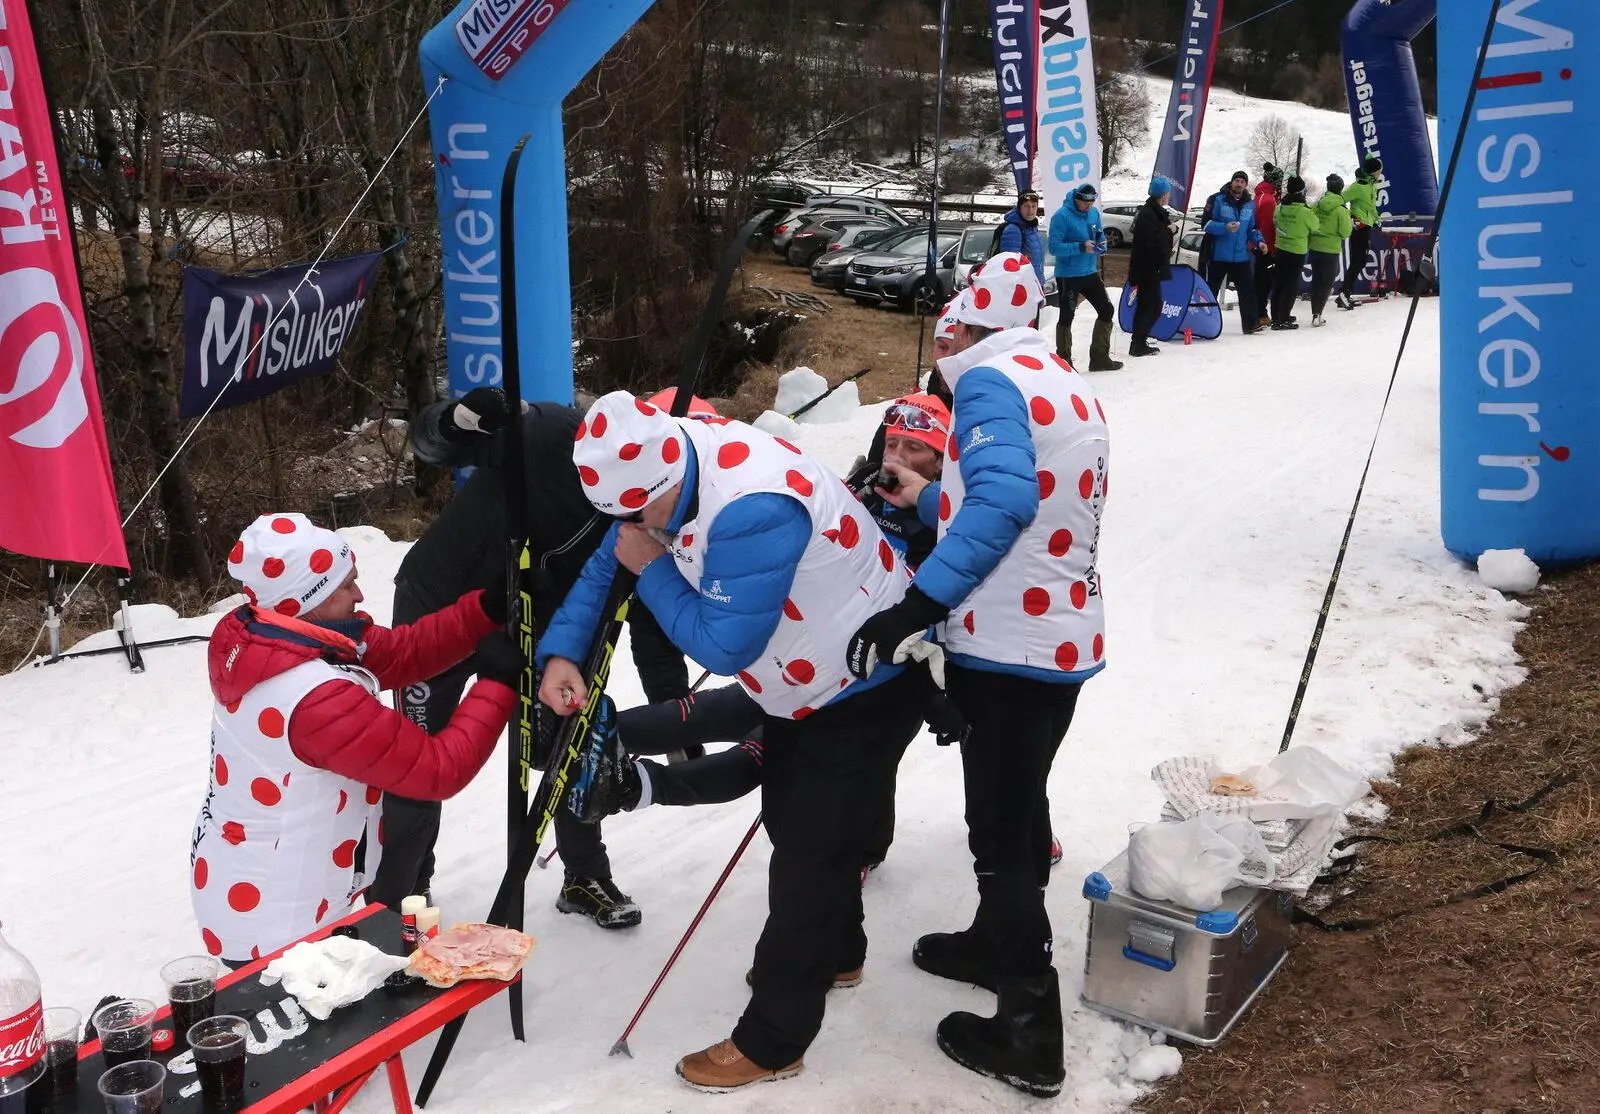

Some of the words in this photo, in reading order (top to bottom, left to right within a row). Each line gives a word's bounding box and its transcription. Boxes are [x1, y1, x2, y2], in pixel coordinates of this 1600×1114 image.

[461, 0, 518, 49] Mils
[491, 0, 566, 74] SPO
[1350, 60, 1391, 206] sprtslager
[439, 123, 502, 398] sluker'n
[301, 576, 329, 603] TRIMTEX
[406, 706, 414, 722] Eie
[415, 706, 428, 731] RAG
[535, 641, 614, 845] FISCHER
[0, 1017, 29, 1031] ORIGINAL
